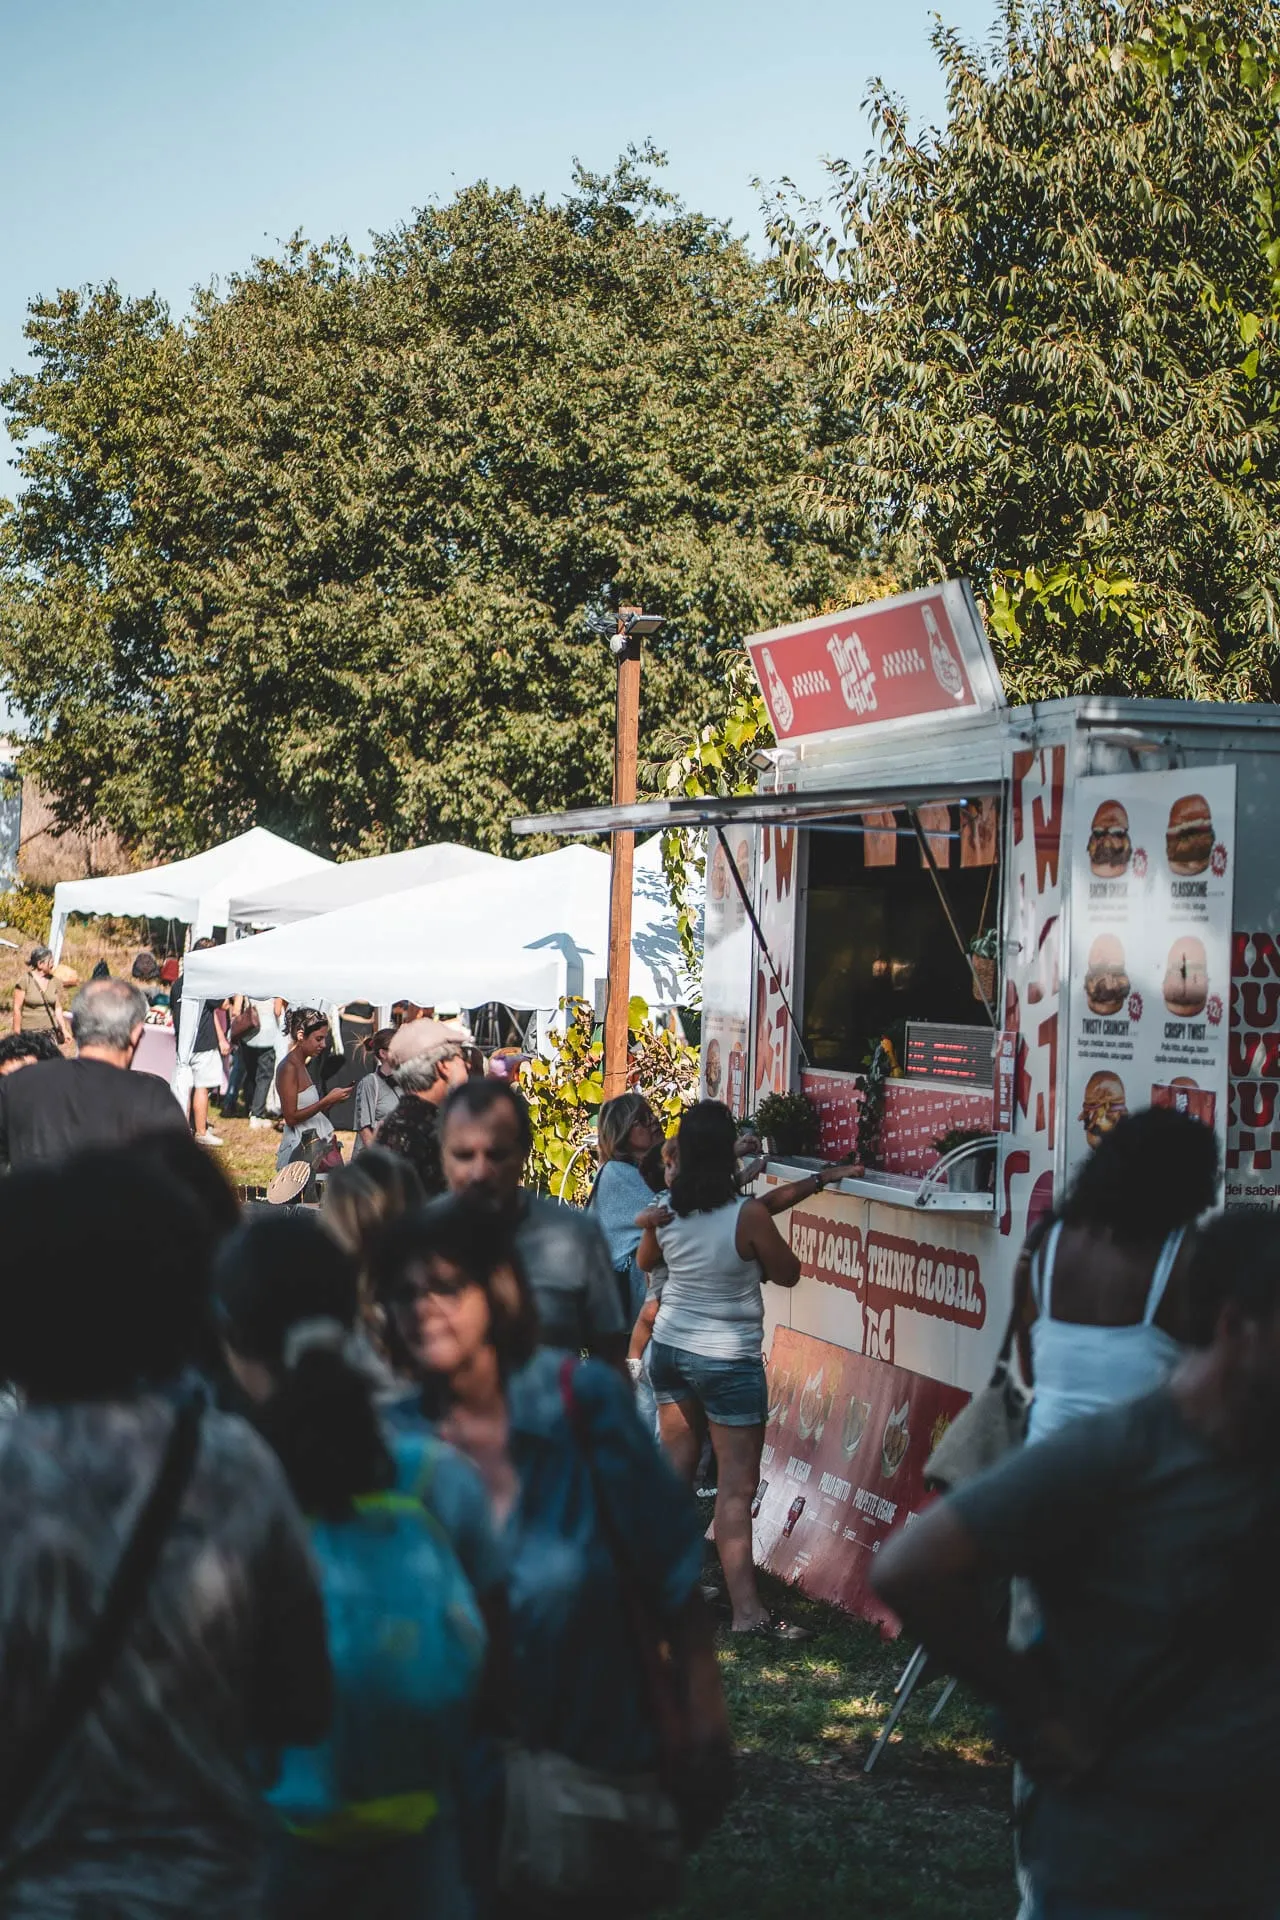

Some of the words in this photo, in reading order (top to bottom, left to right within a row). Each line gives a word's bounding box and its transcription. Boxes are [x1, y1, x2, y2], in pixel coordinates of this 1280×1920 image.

[791, 1224, 817, 1265] EAT
[817, 1231, 864, 1288] LOCAL,
[867, 1245, 916, 1295] THINK
[916, 1257, 982, 1314] GLOBAL.
